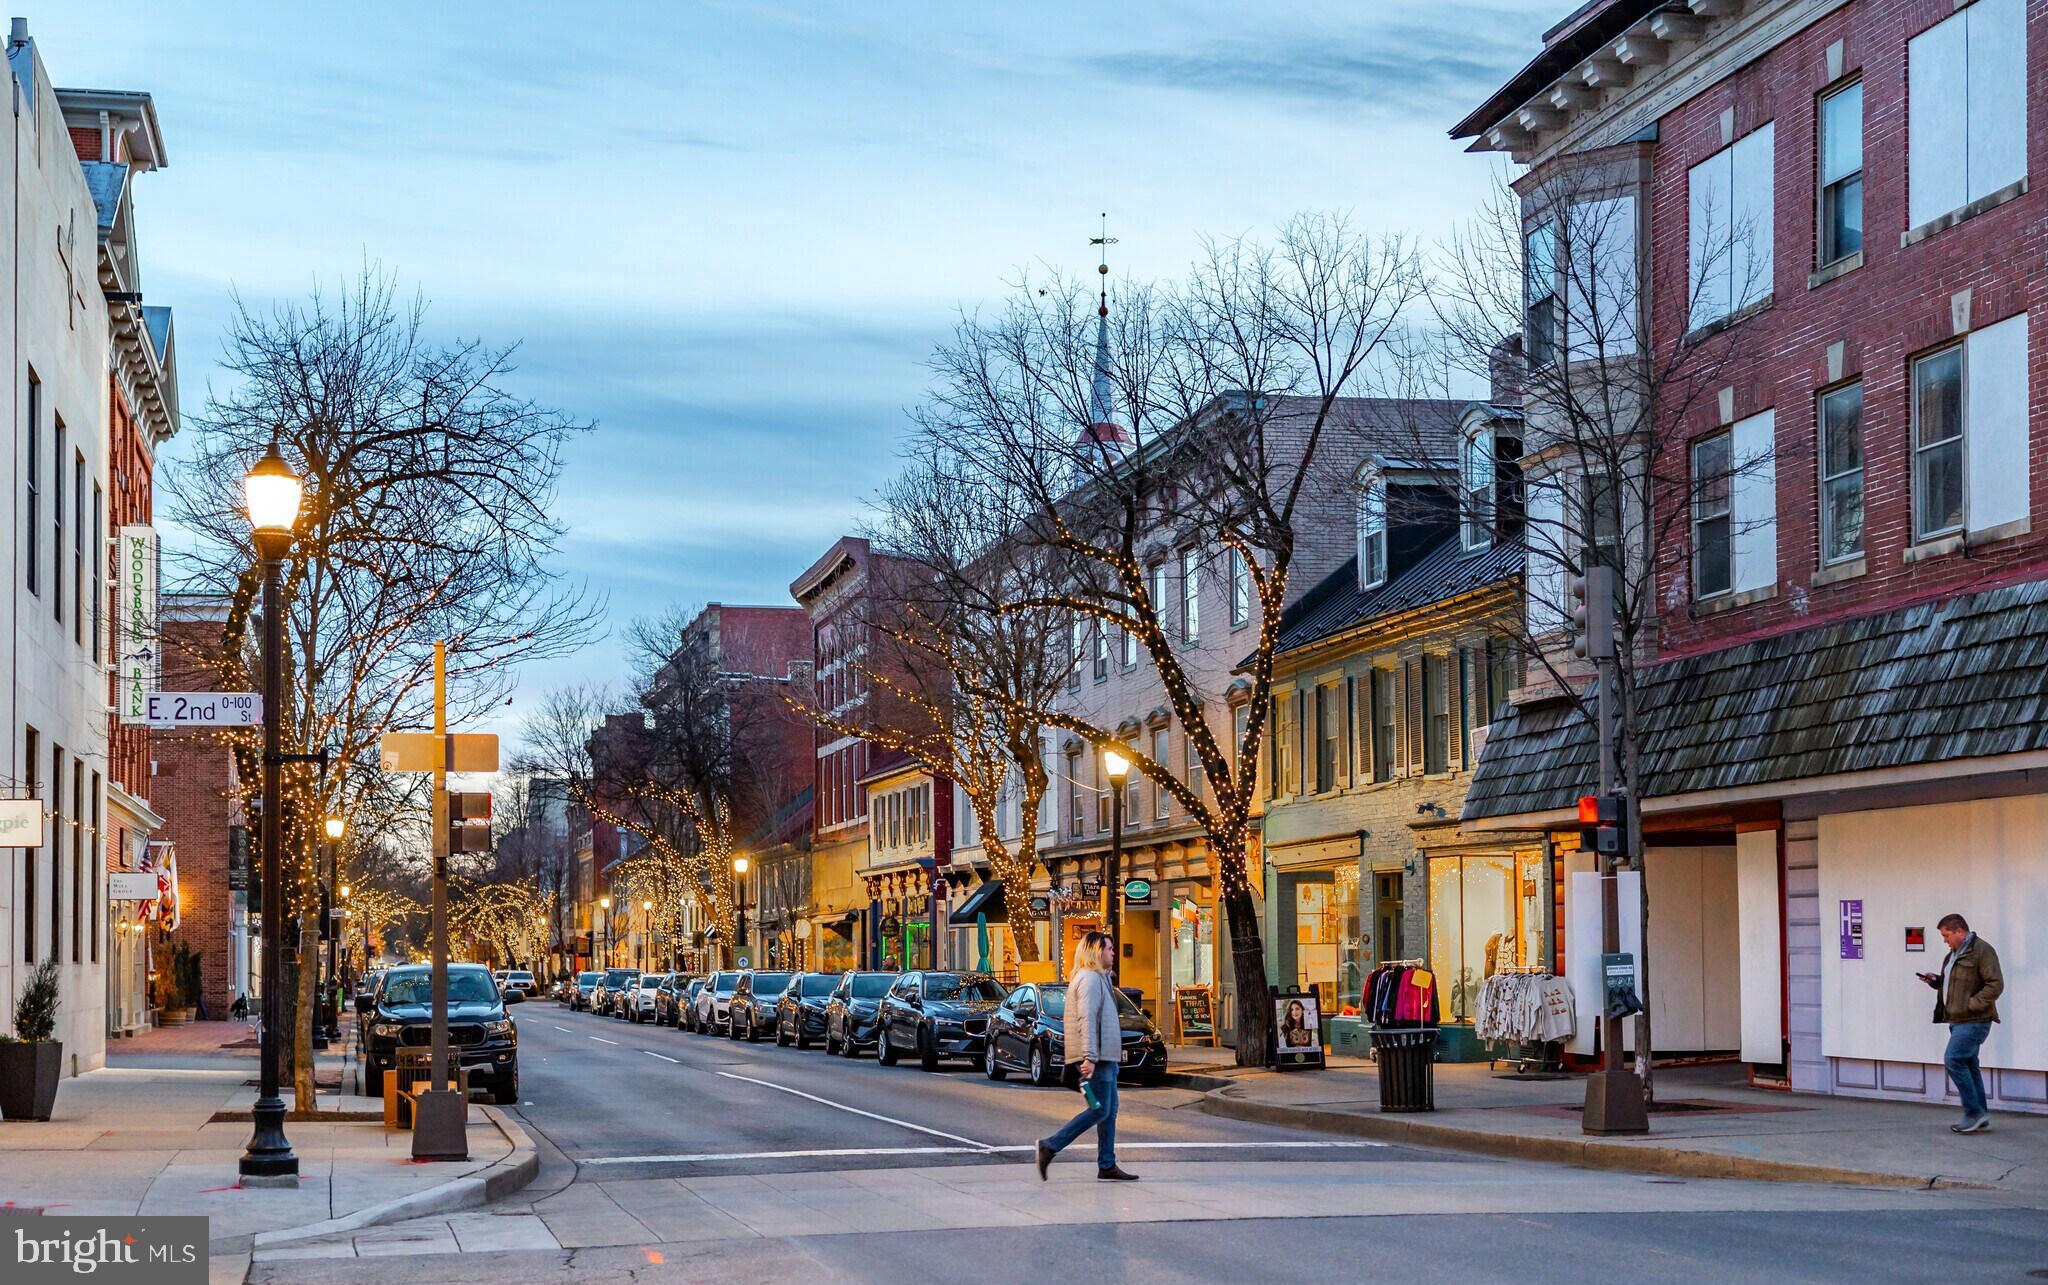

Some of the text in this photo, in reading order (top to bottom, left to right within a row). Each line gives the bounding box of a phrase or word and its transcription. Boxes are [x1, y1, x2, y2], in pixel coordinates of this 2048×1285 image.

[131, 537, 145, 717] WOODSBORO BANK
[148, 697, 215, 720] E. 2nd
[221, 697, 252, 709] 0-100
[240, 711, 252, 722] St
[0, 815, 30, 834] pie
